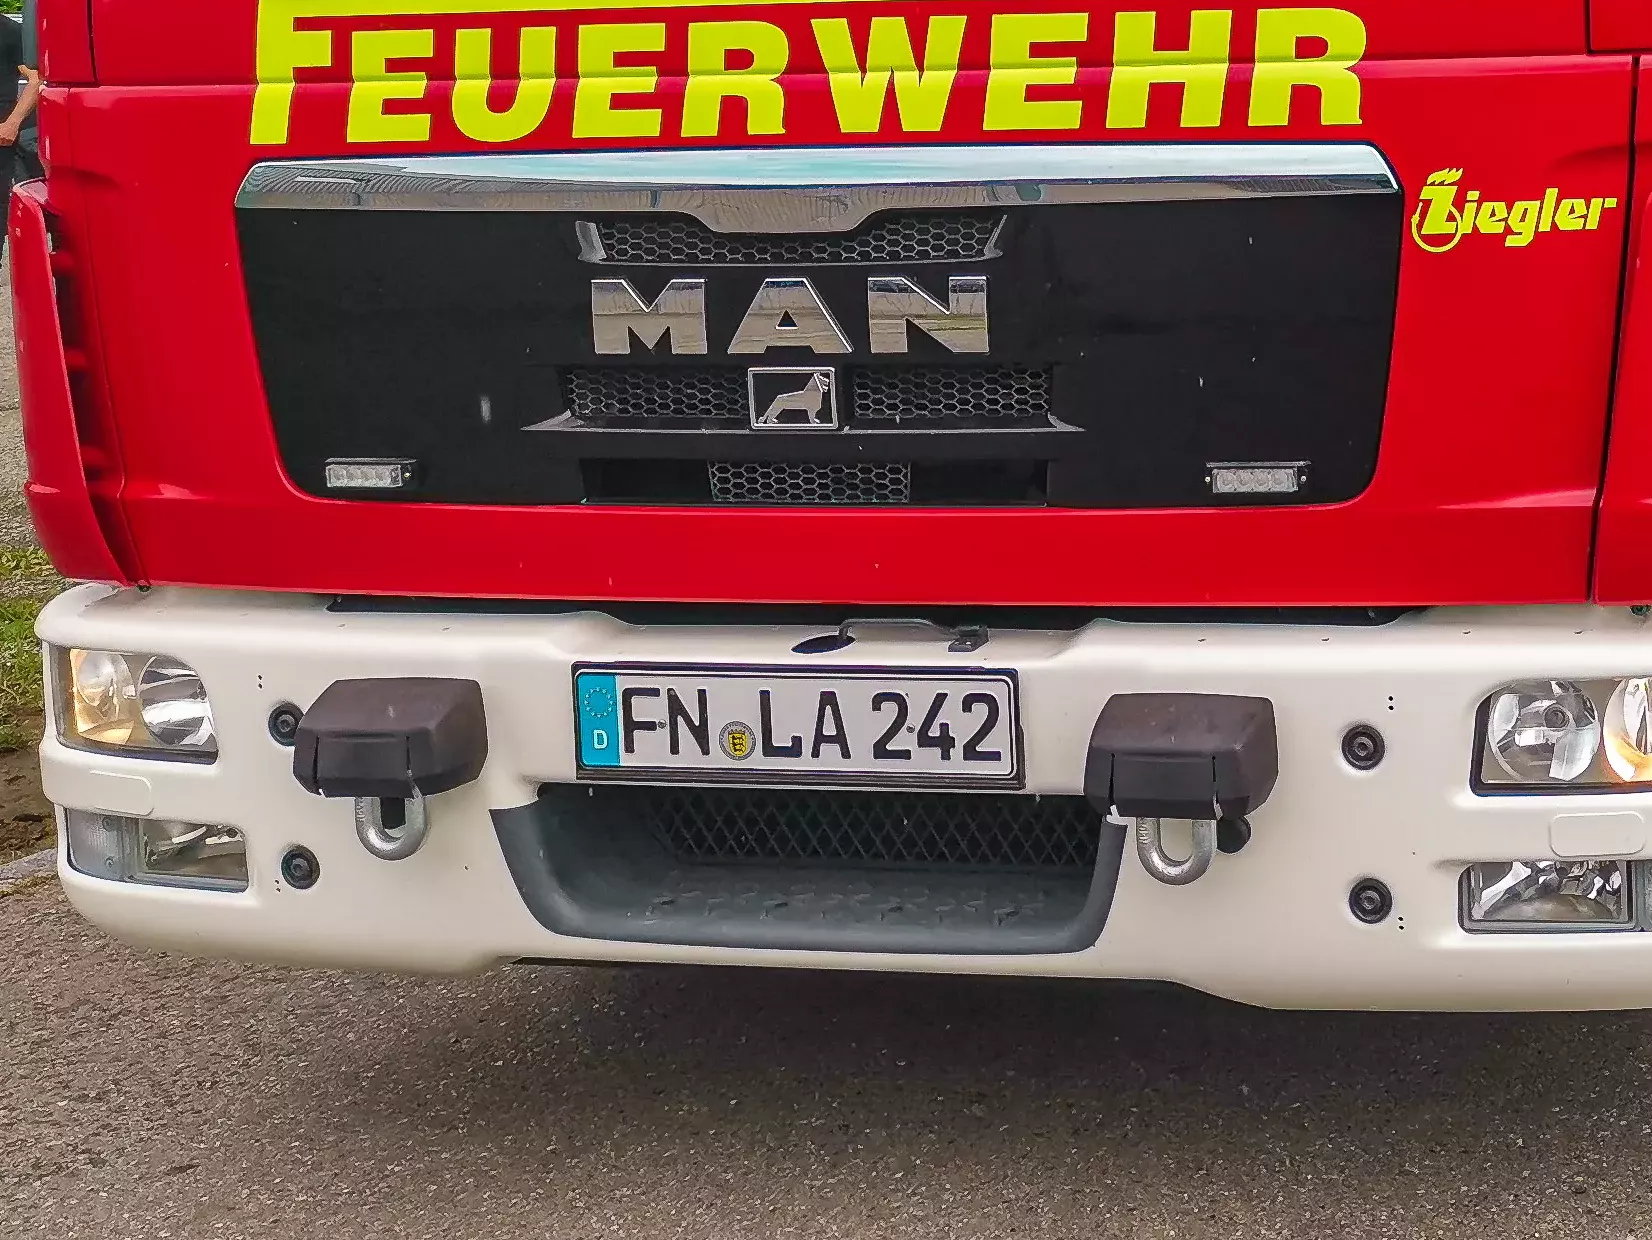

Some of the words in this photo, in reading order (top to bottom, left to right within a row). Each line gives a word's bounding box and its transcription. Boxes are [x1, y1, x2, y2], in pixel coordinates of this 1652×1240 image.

[1411, 170, 1618, 252] Ziegler
[590, 275, 991, 356] MAN
[592, 728, 608, 750] D
[620, 686, 711, 756] FN
[759, 689, 851, 761] LA
[871, 691, 1002, 762] 242
